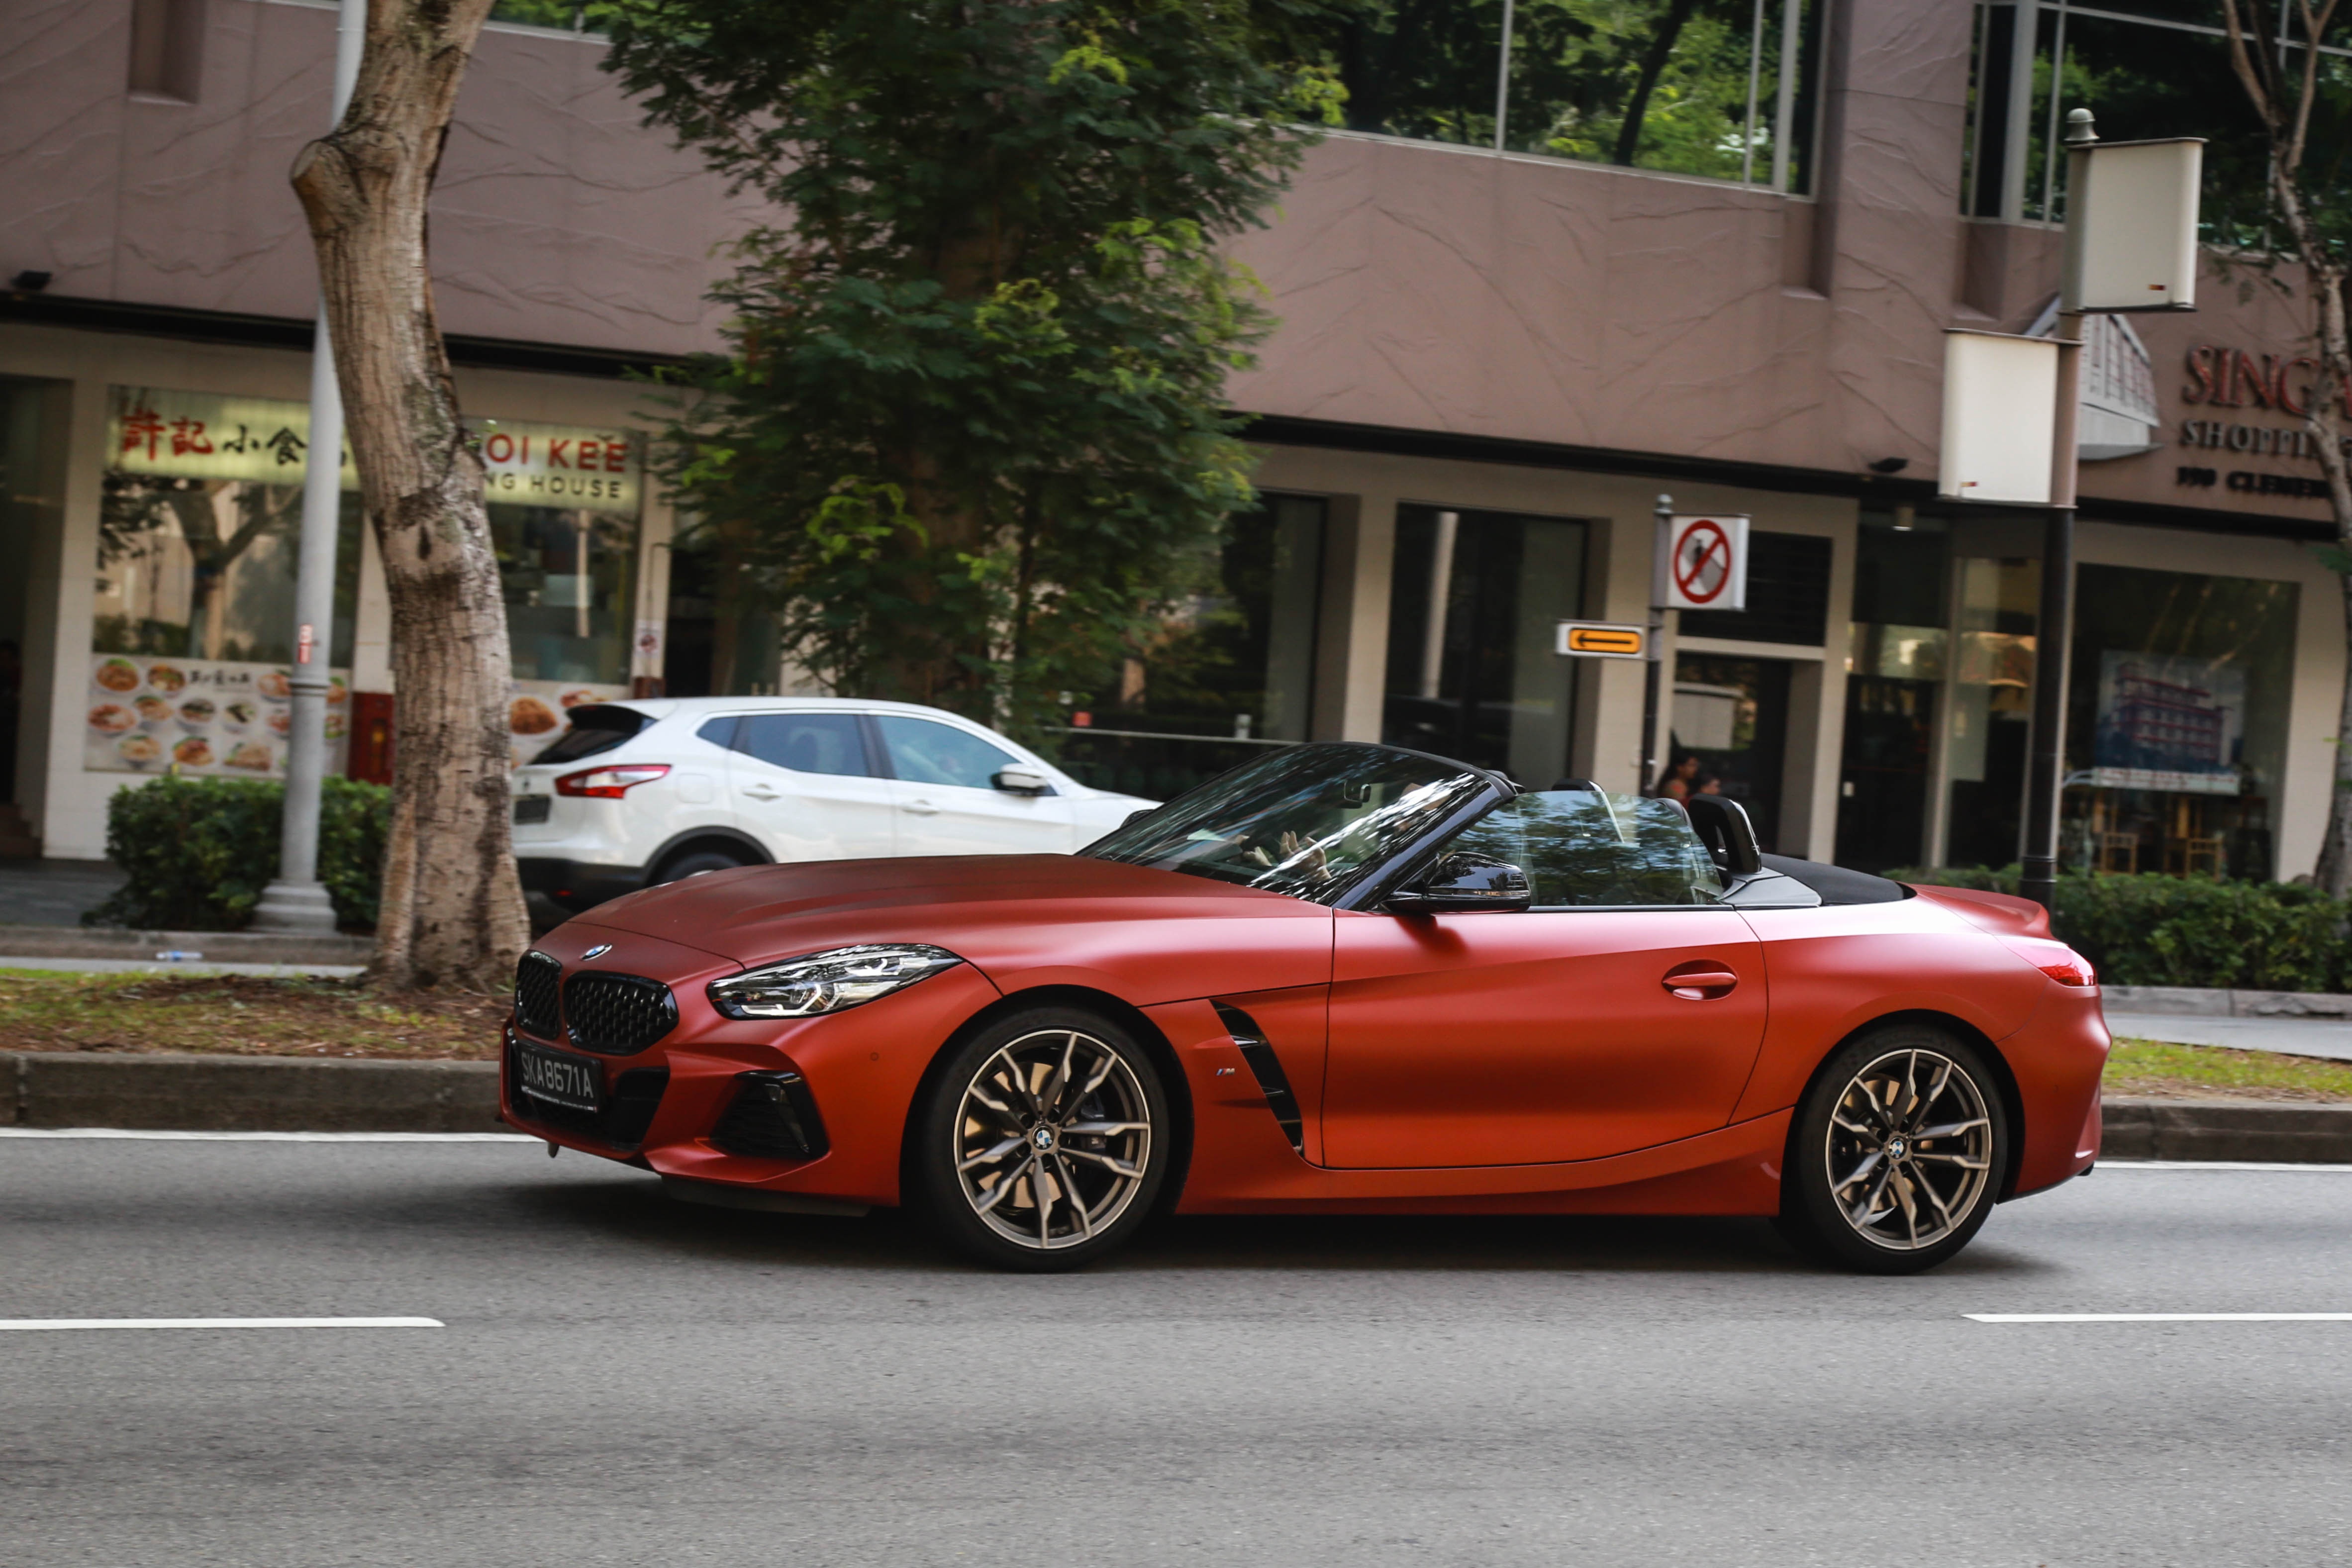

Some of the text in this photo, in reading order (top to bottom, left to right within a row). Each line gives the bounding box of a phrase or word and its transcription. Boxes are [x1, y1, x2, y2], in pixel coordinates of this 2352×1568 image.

[548, 439, 629, 473] KEE
[531, 475, 621, 498] HOUSE
[521, 1051, 594, 1099] SKA8671A
